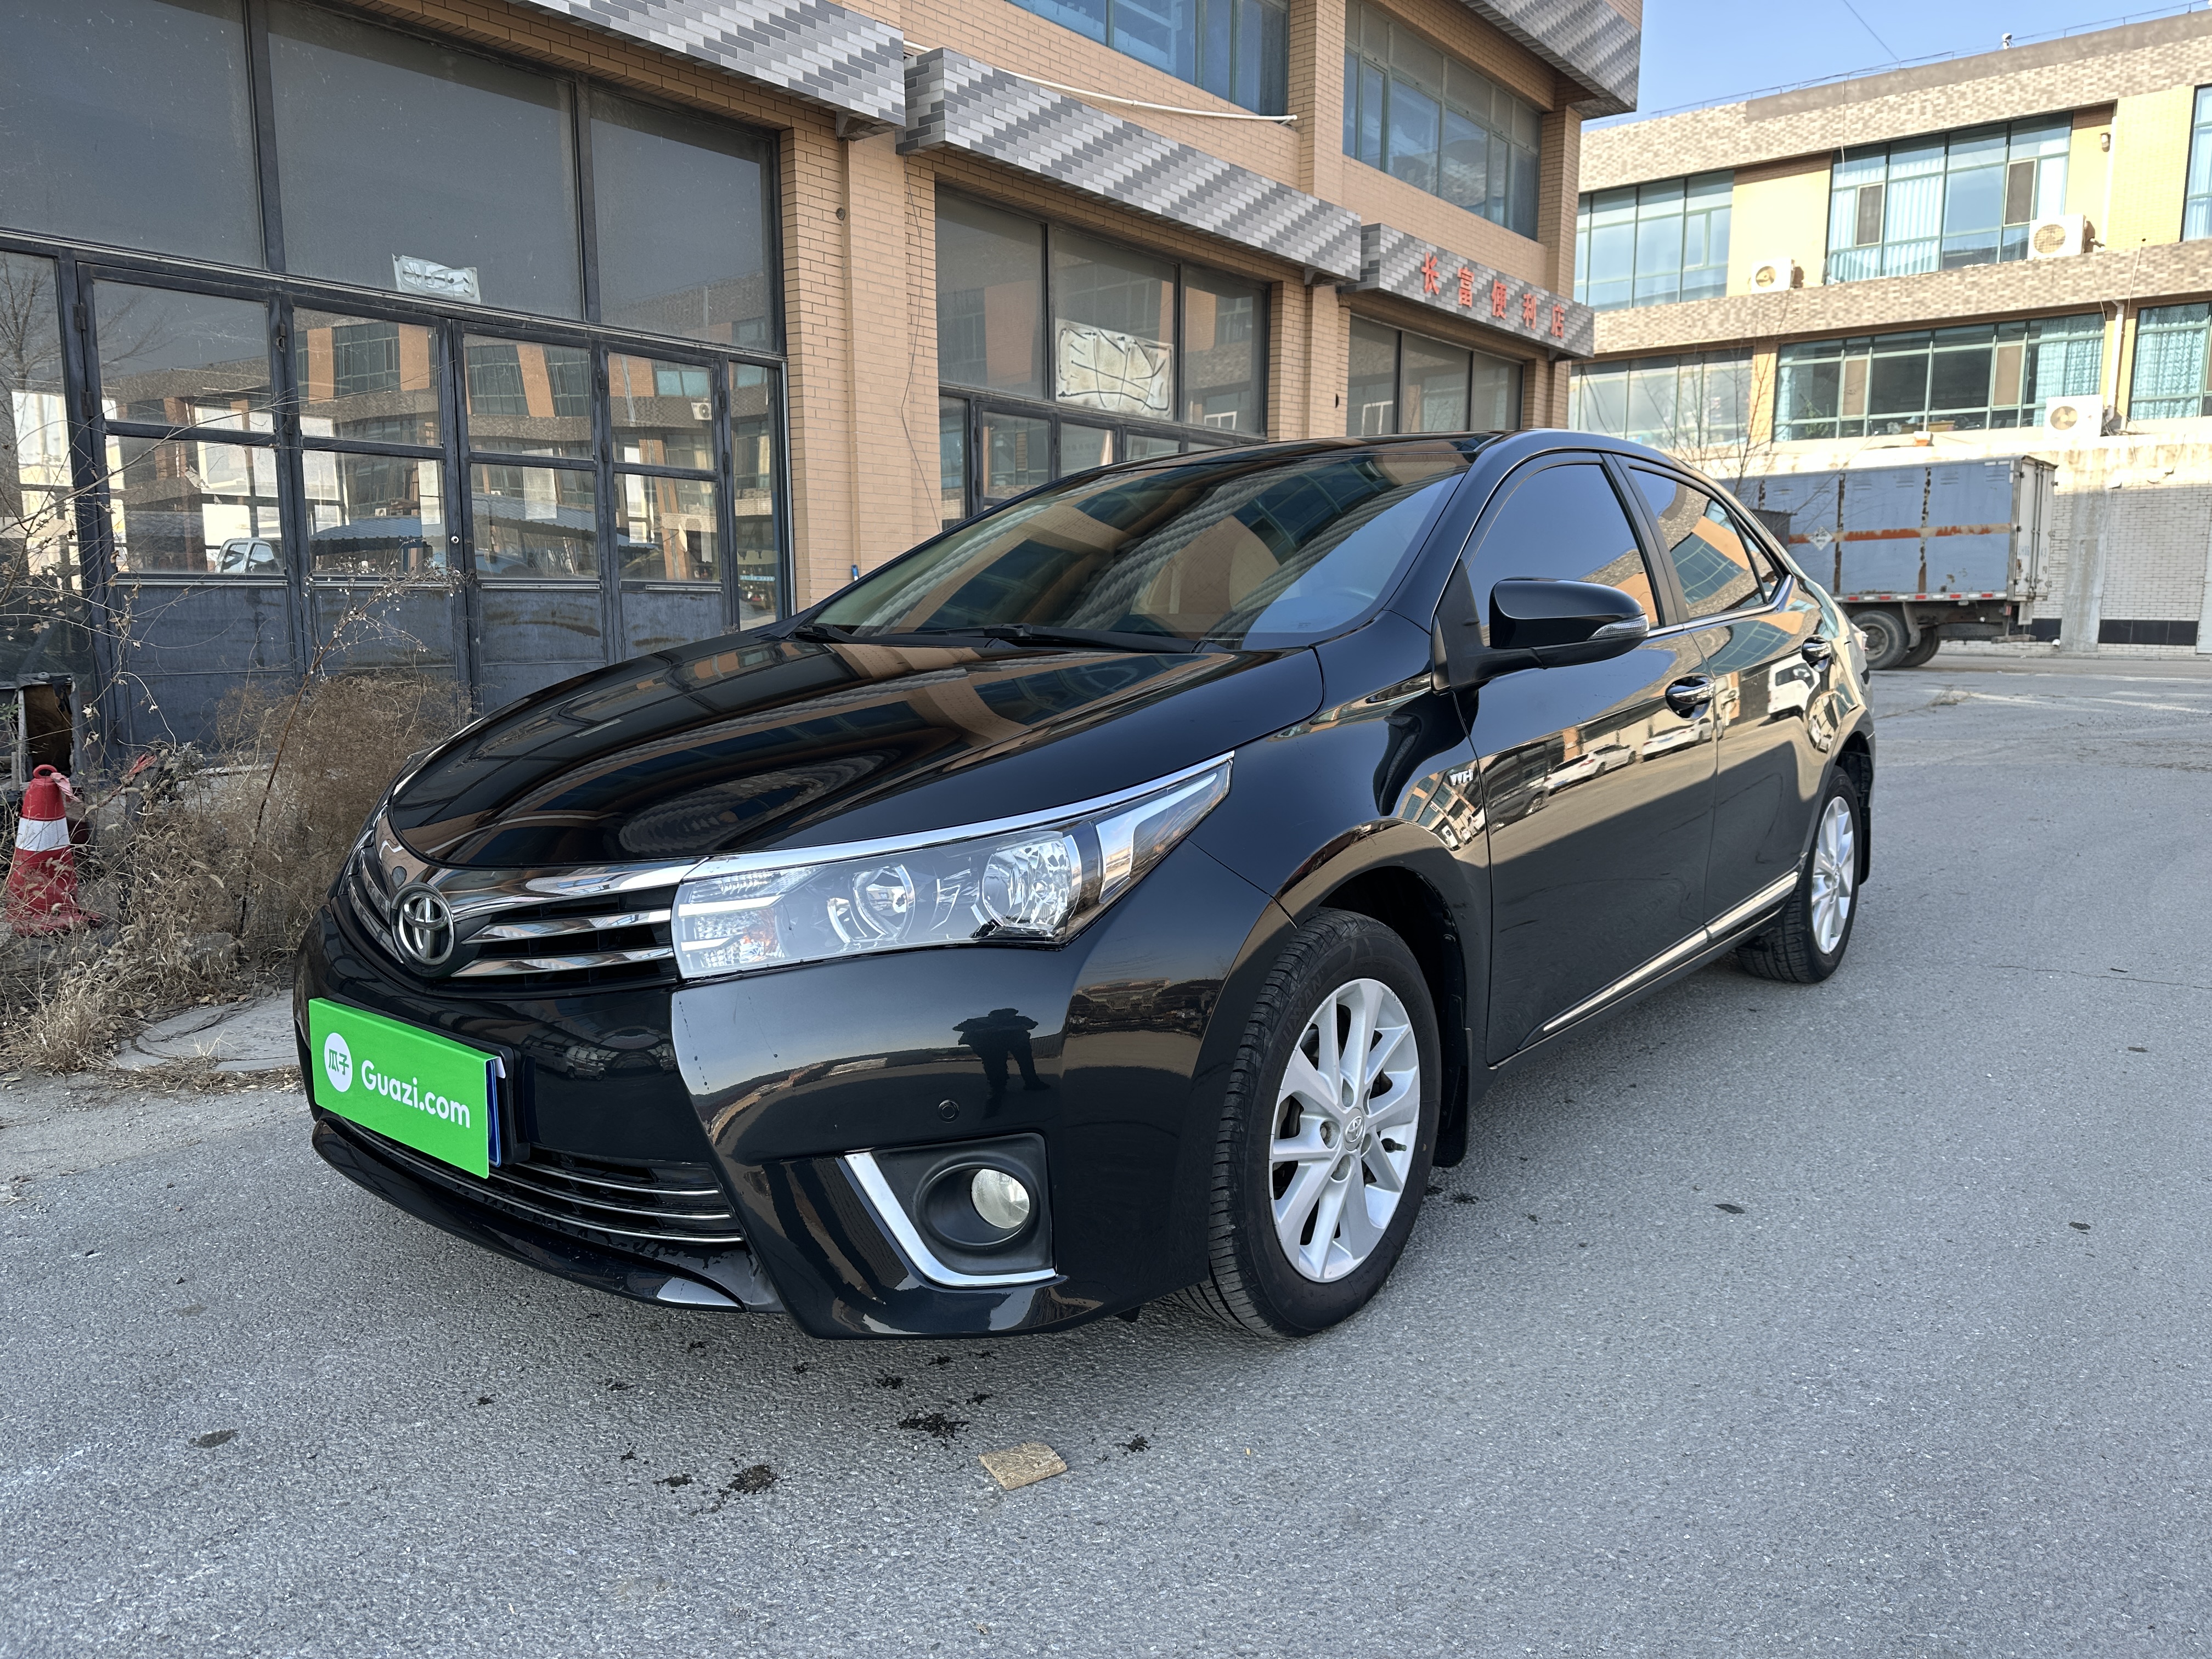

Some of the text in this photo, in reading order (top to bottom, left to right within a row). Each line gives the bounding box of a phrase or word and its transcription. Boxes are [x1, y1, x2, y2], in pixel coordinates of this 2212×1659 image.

[1421, 252, 1565, 338] 长富便利店
[329, 1048, 349, 1076] 瓜子
[361, 1060, 470, 1128] Guazi.com
